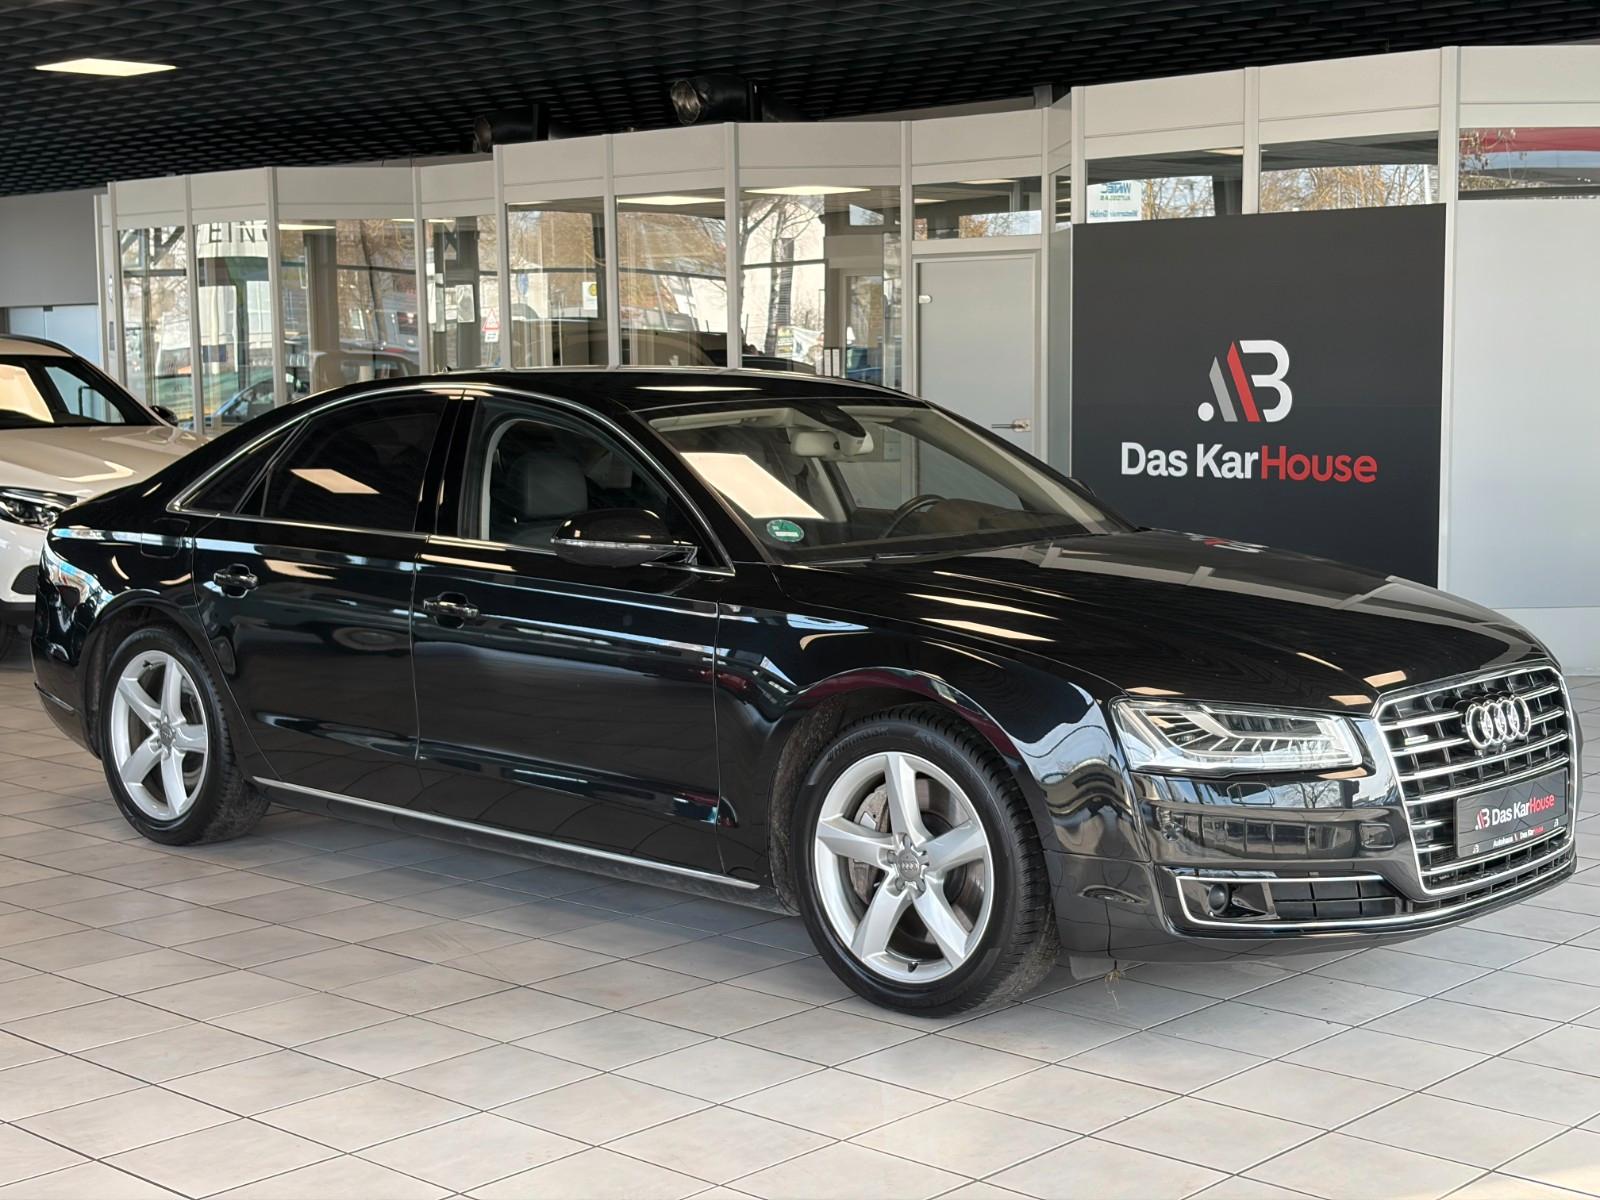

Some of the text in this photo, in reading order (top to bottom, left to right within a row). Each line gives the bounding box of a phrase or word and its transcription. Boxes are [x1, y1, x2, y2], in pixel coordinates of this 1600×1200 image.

[1121, 441, 1378, 483] Das KarHouse
[1491, 808, 1513, 827] Das
[1513, 794, 1556, 820] KarHouse
